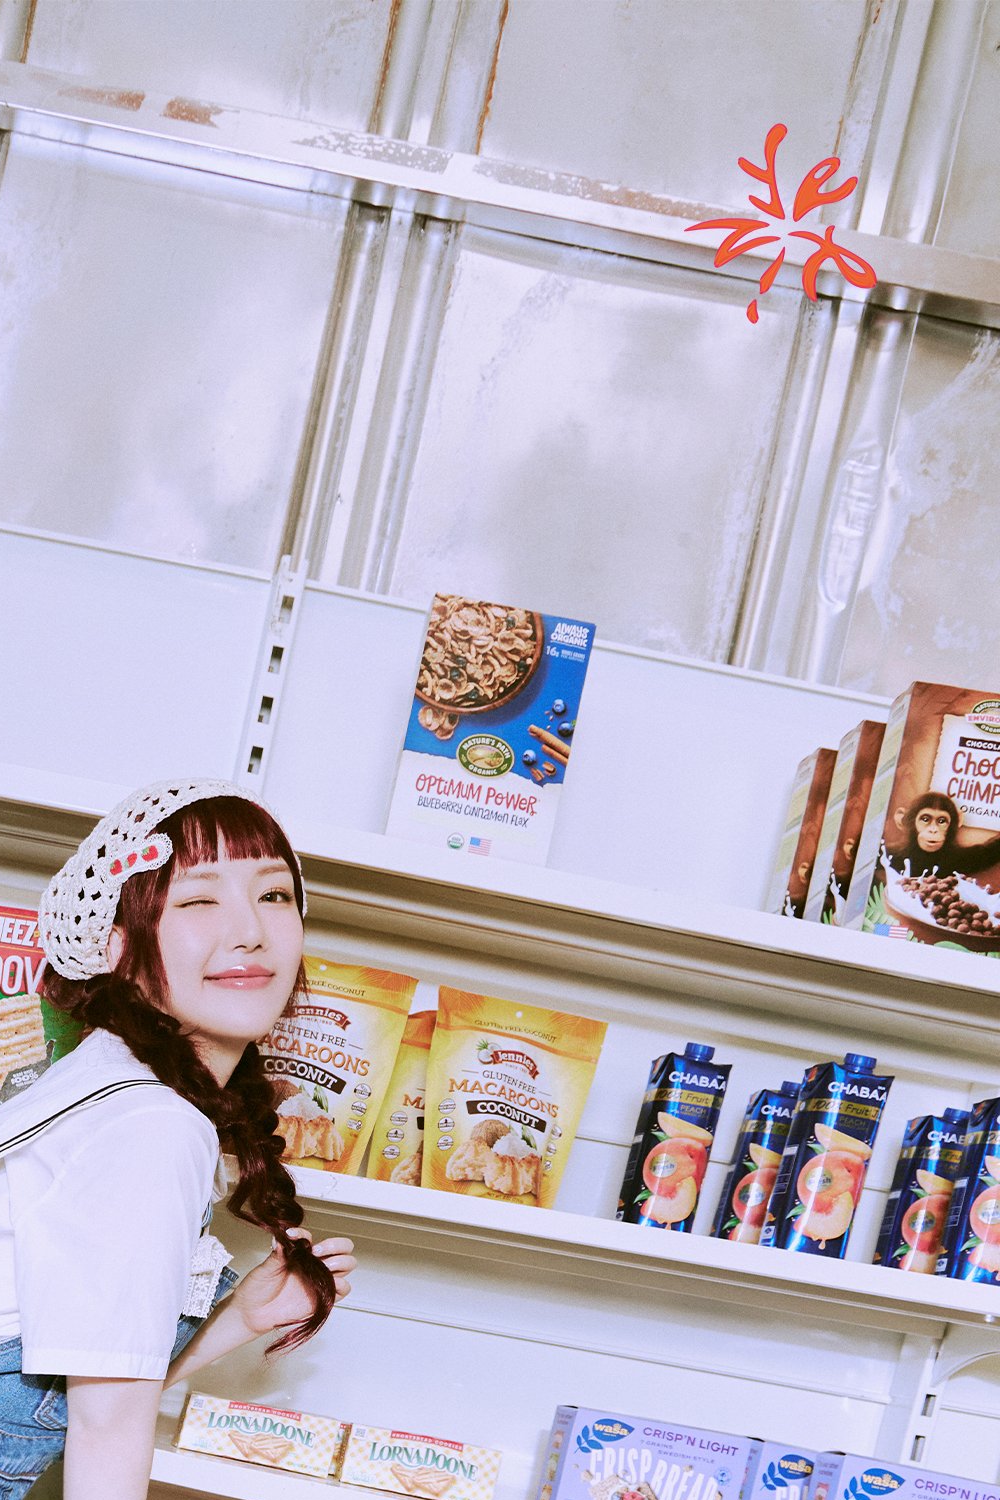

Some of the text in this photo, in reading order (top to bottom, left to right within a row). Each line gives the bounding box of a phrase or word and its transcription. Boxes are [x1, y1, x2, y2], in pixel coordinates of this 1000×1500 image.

[551, 632, 587, 647] ORGANIC
[554, 622, 589, 639] ALWAYS
[960, 804, 1000, 819] ORGAN
[274, 1022, 319, 1041] GLUTEN
[321, 1033, 347, 1048] FREE
[256, 1033, 371, 1077] ACAROONS
[264, 1058, 337, 1089] COCONUT
[482, 1069, 537, 1095] GLUTEN FREE
[449, 1078, 560, 1119] MACAROONS
[828, 1081, 887, 1102] CHABAA
[476, 1101, 539, 1128] COCONUT
[845, 1103, 870, 1117] Fruit
[207, 1412, 316, 1448] LORNA DOONE
[642, 1427, 739, 1457] CRISP'N LIGHT
[369, 1442, 479, 1481] LORNA DOONE
[914, 1478, 971, 1500] CRISP'N
